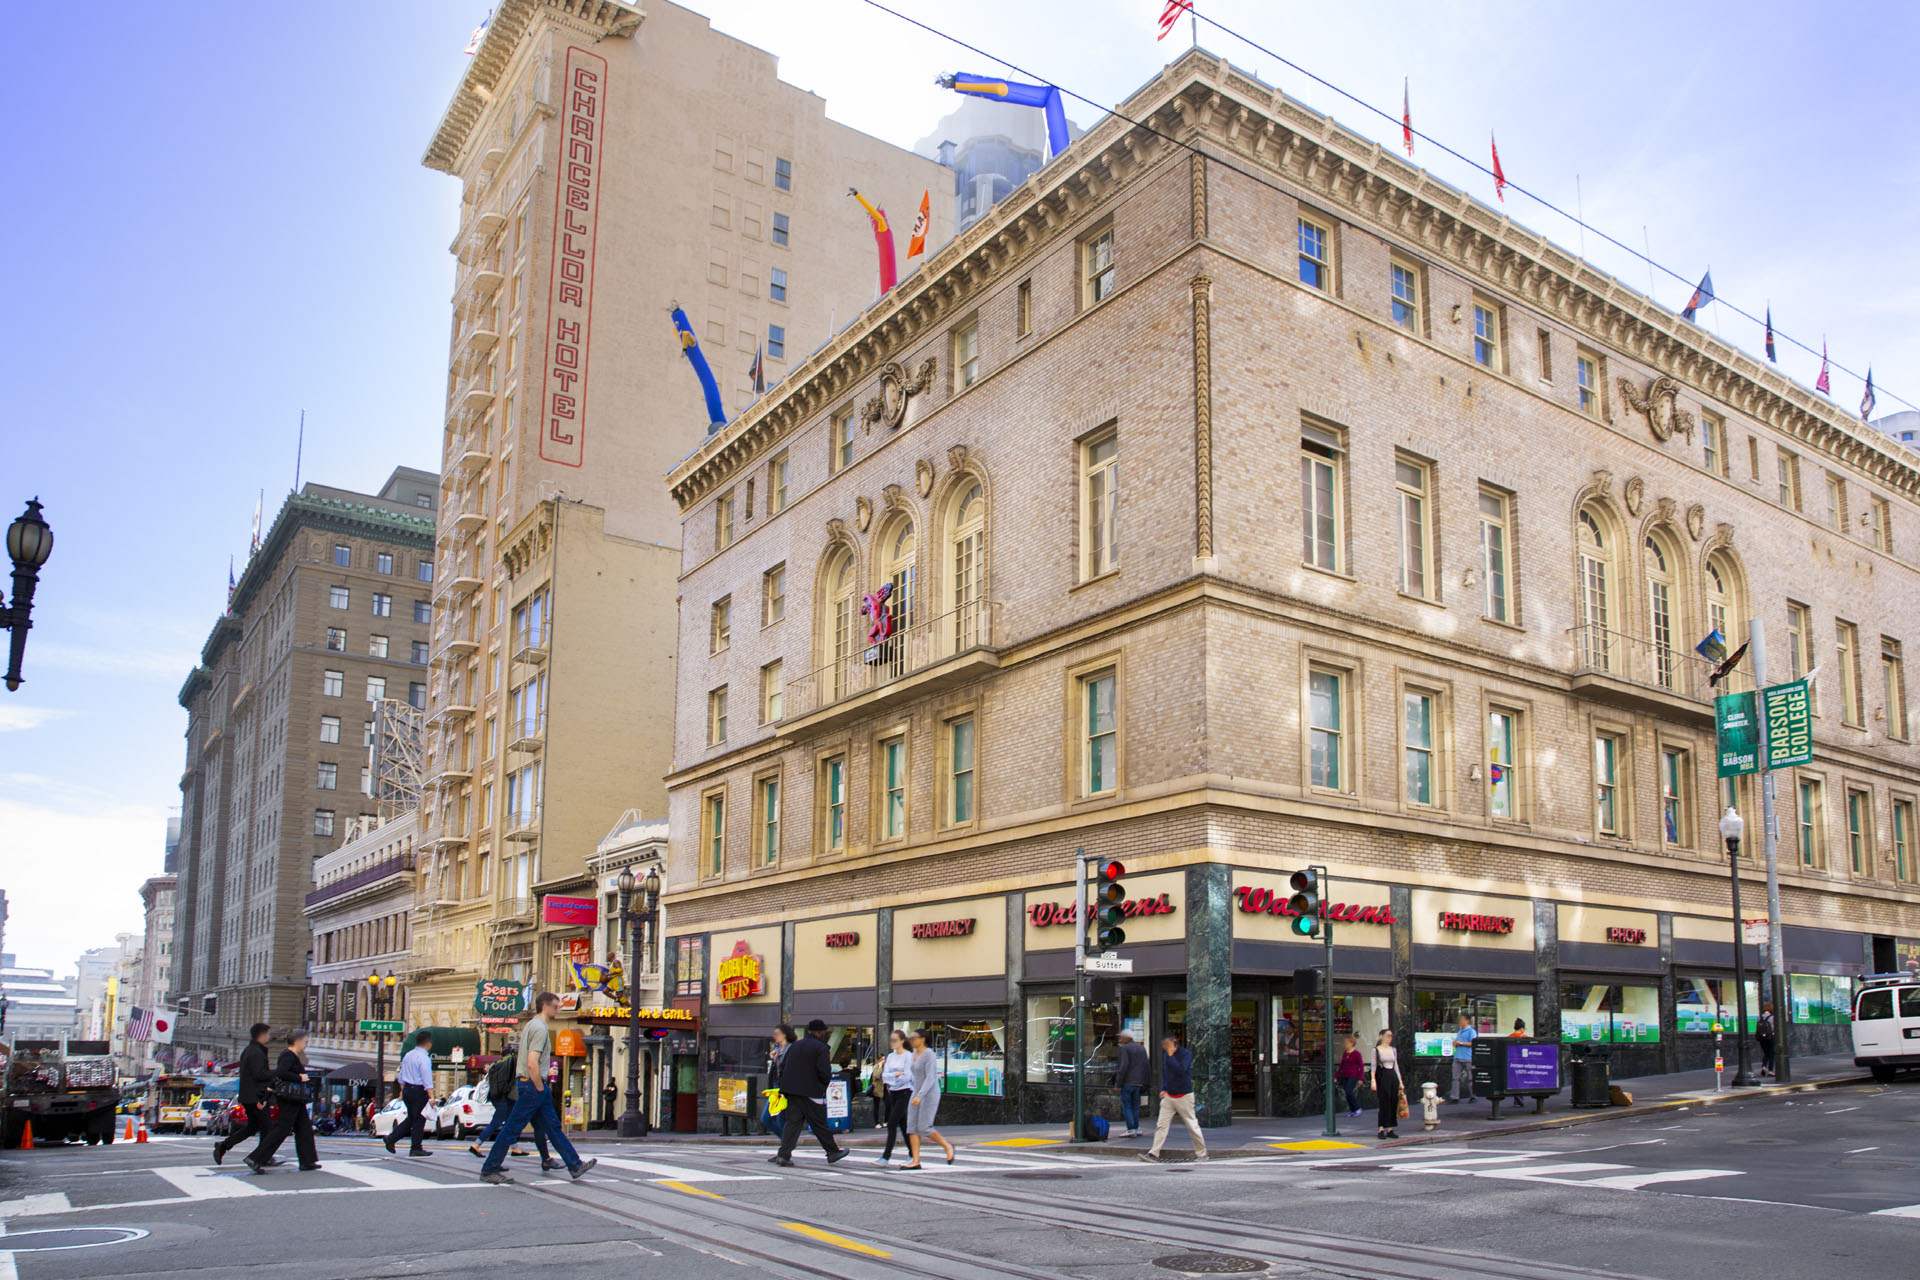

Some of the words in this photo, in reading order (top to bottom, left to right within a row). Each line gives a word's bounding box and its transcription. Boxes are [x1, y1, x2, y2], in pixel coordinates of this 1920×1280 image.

[560, 68, 597, 307] CHANCELLOR
[551, 317, 581, 445] HOTEL
[1768, 694, 1790, 760] BABSON
[1788, 691, 1808, 756] COLLEGE
[1723, 754, 1753, 766] BABSON
[912, 918, 974, 939] PHARMACY
[1444, 912, 1515, 933] PHARMACY
[825, 932, 856, 947] PHOTO
[1612, 927, 1647, 943] PHOTO
[1095, 961, 1122, 969] Sutter
[482, 983, 519, 996] Sears
[721, 979, 750, 1000] GIFTS
[309, 995, 317, 1013] DSW
[328, 994, 336, 1013] DSW
[346, 992, 355, 1012] DSW
[481, 996, 516, 1011] Food
[595, 1007, 616, 1018] TAP
[652, 1009, 660, 1019] &
[662, 1009, 692, 1020] GRILL
[349, 1078, 368, 1086] DSW
